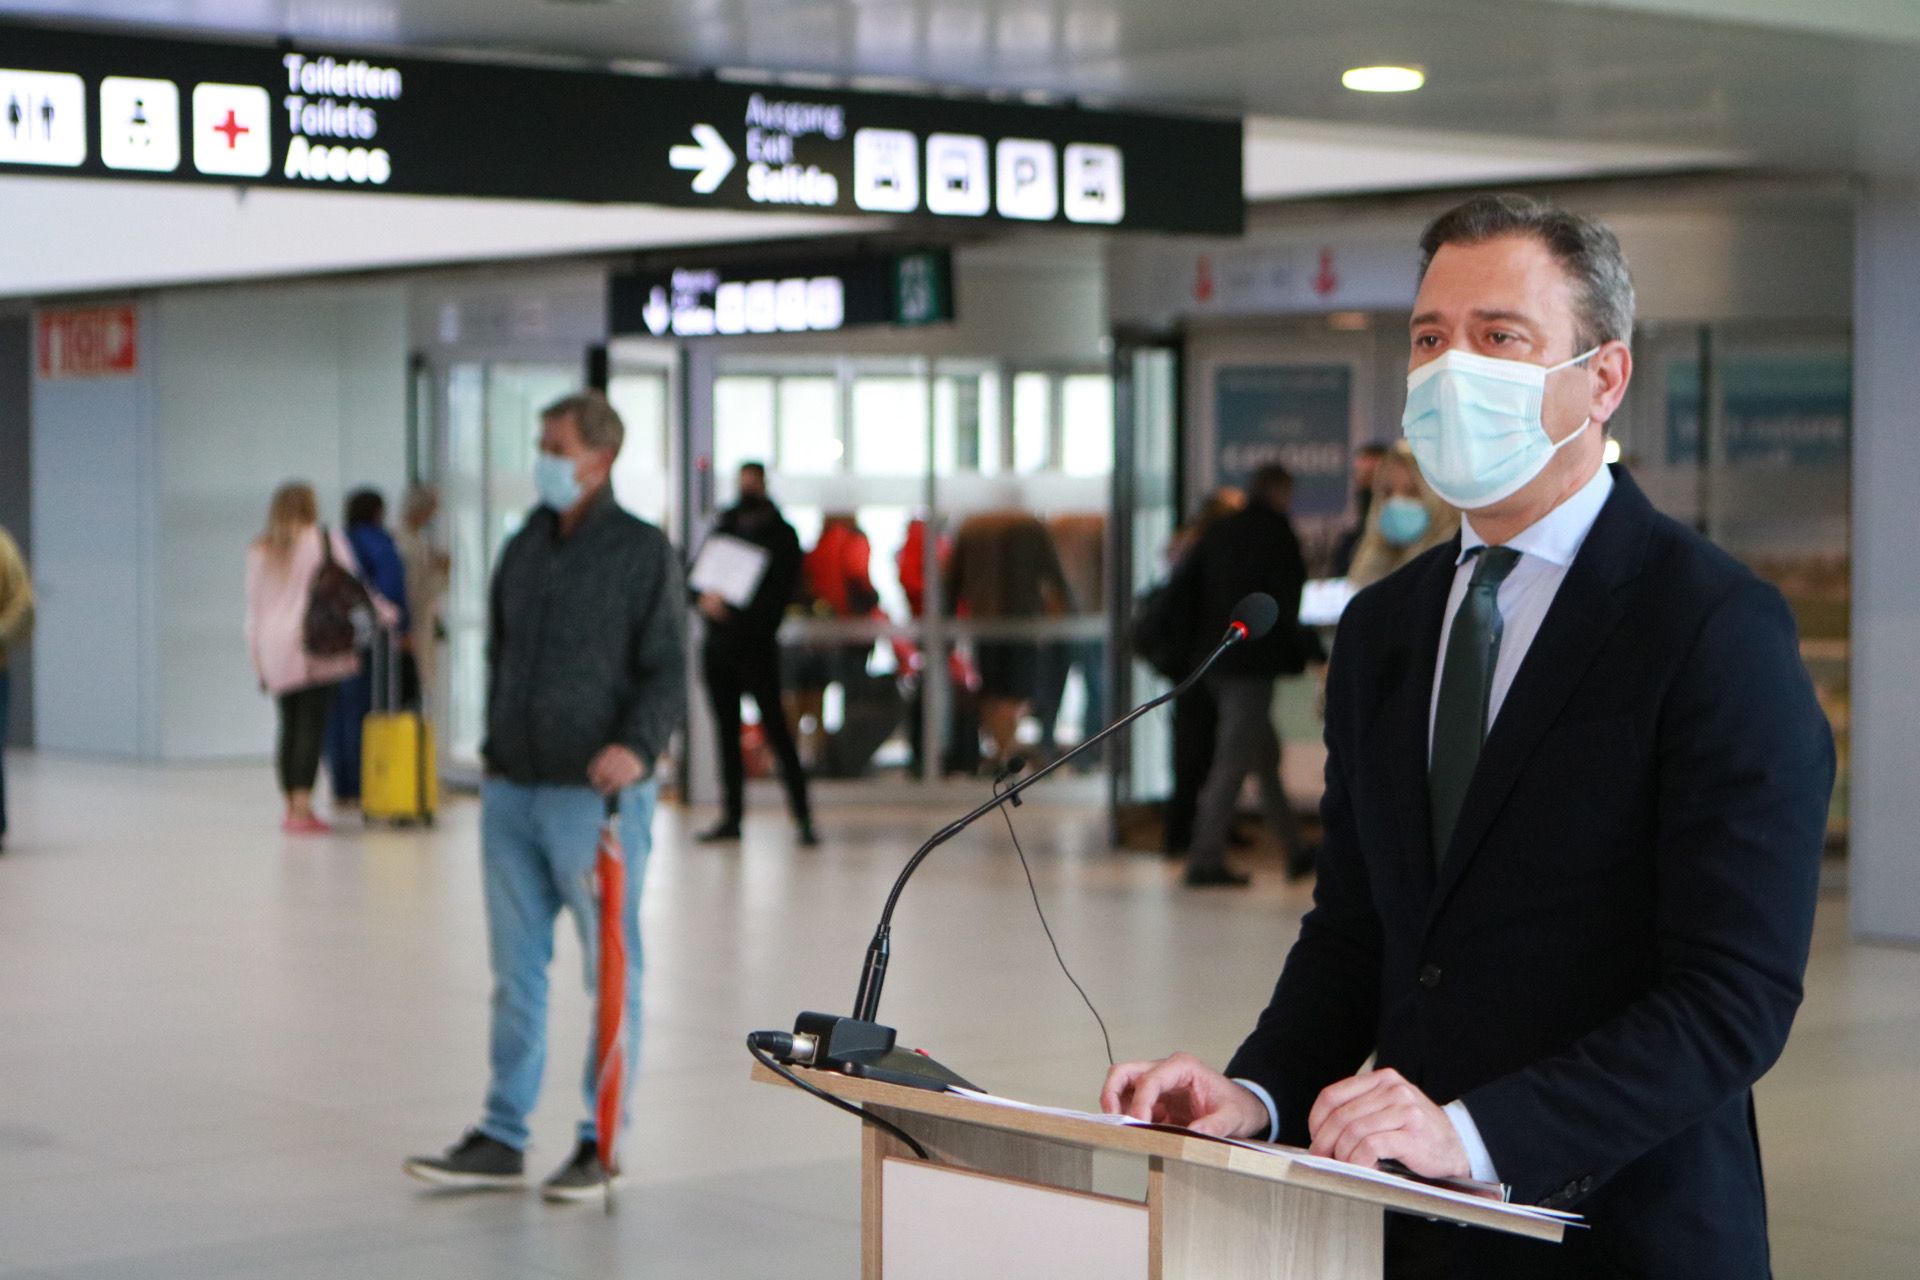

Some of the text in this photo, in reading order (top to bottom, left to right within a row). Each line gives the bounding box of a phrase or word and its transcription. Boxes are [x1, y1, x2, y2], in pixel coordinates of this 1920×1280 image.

[283, 53, 402, 99] Toiletten
[284, 95, 378, 139] Toilets
[745, 92, 845, 139] Ausgang
[747, 127, 793, 164] Exit
[747, 162, 838, 206] Salida
[1014, 157, 1036, 197] P
